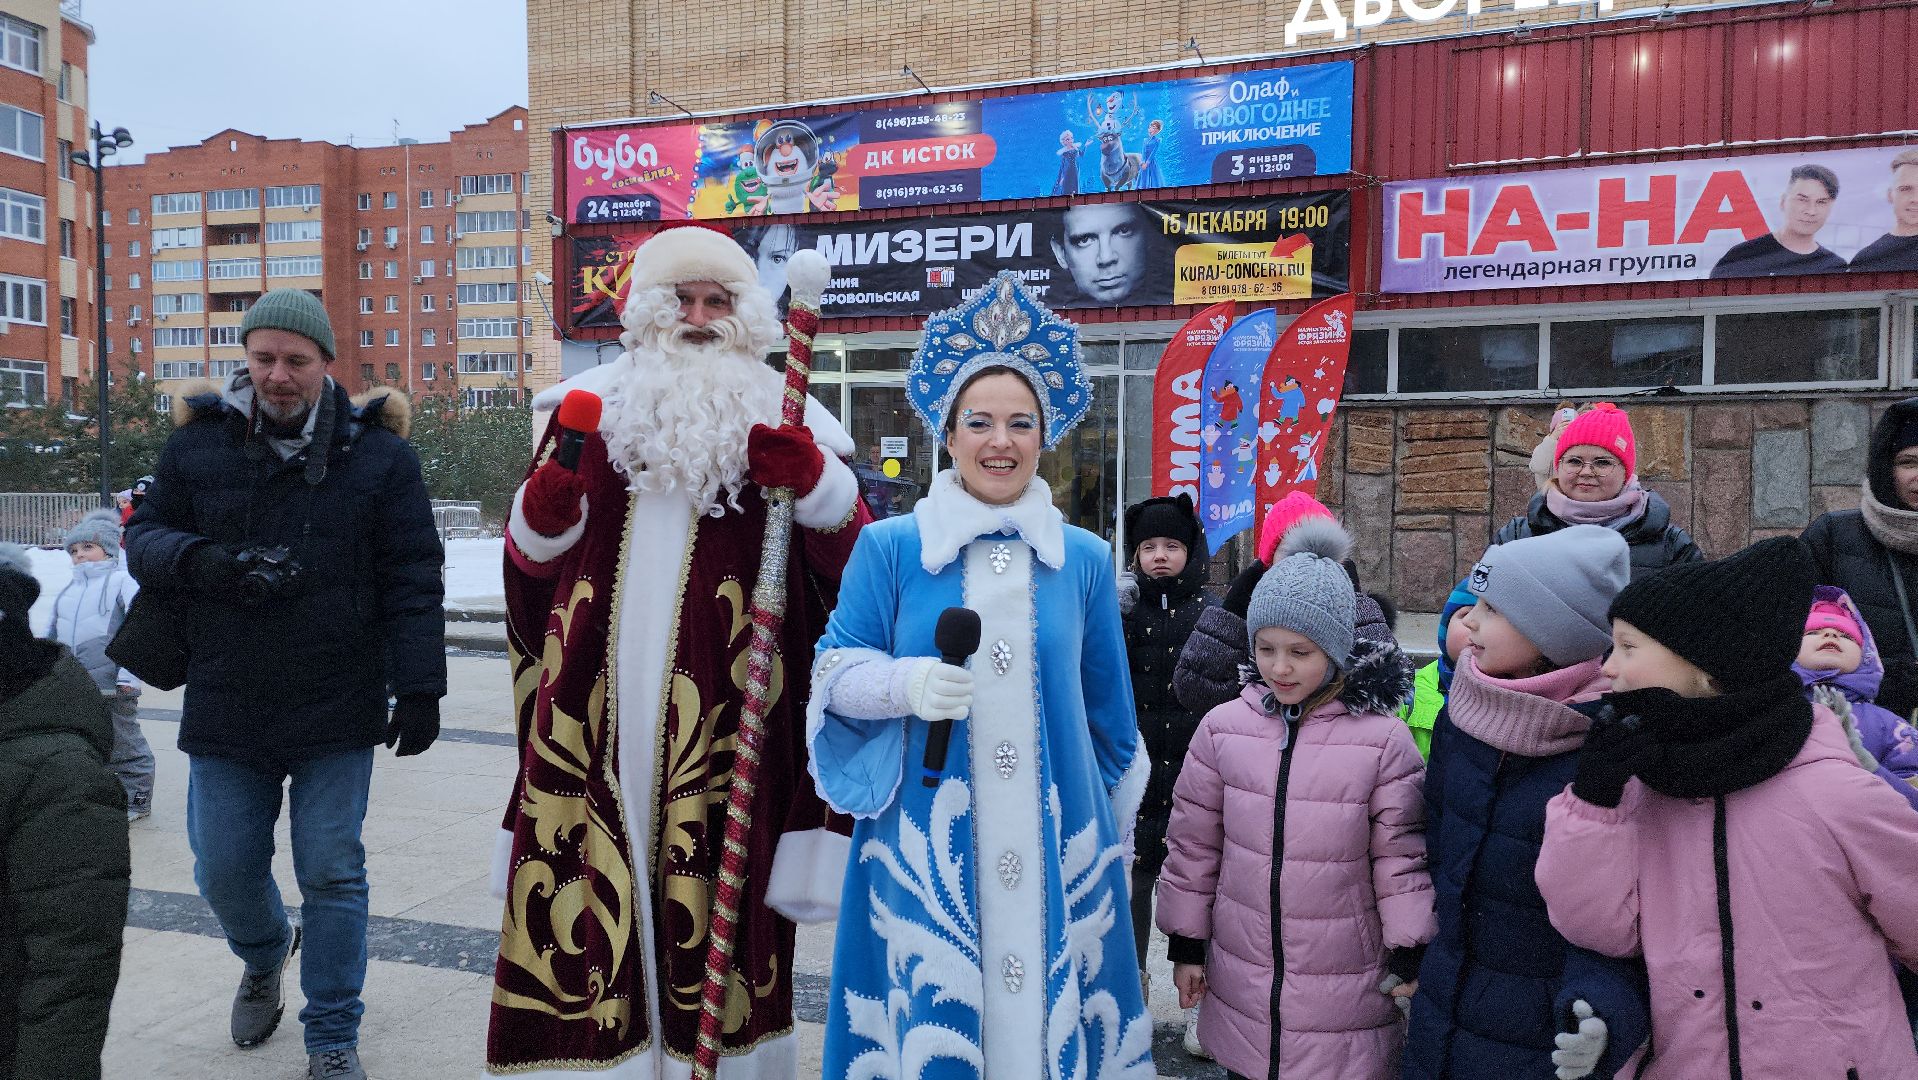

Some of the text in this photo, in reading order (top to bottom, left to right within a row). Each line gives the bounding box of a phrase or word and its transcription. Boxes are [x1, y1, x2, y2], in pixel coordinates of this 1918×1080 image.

[1230, 76, 1299, 104] Олаф и
[1193, 97, 1332, 130] НОВОГОДНЕЕ
[1201, 122, 1322, 146] ПРИКЛЮЧЕНИЕ
[864, 142, 976, 170] ДК ИСТОК
[1230, 152, 1294, 176] 3 января
[1260, 162, 1291, 174] 12:00
[587, 200, 652, 218] 24 декабря
[620, 209, 644, 218] 12:00
[1162, 205, 1330, 235] 15 ДЕКАБРЯ 19:00
[1397, 169, 1770, 260] НА-НА
[815, 222, 1033, 266] МИЗЕРИ
[1217, 250, 1250, 260] БИЛЕТЫ
[1180, 262, 1306, 282] KURAJ-CONCERT.RU
[1444, 253, 1698, 281] легендарная группа
[820, 290, 920, 305] БРОВОЛЬСКАЯ
[1298, 331, 1347, 341] ФРЯЗИНО
[1209, 498, 1253, 521] ЗИМ
